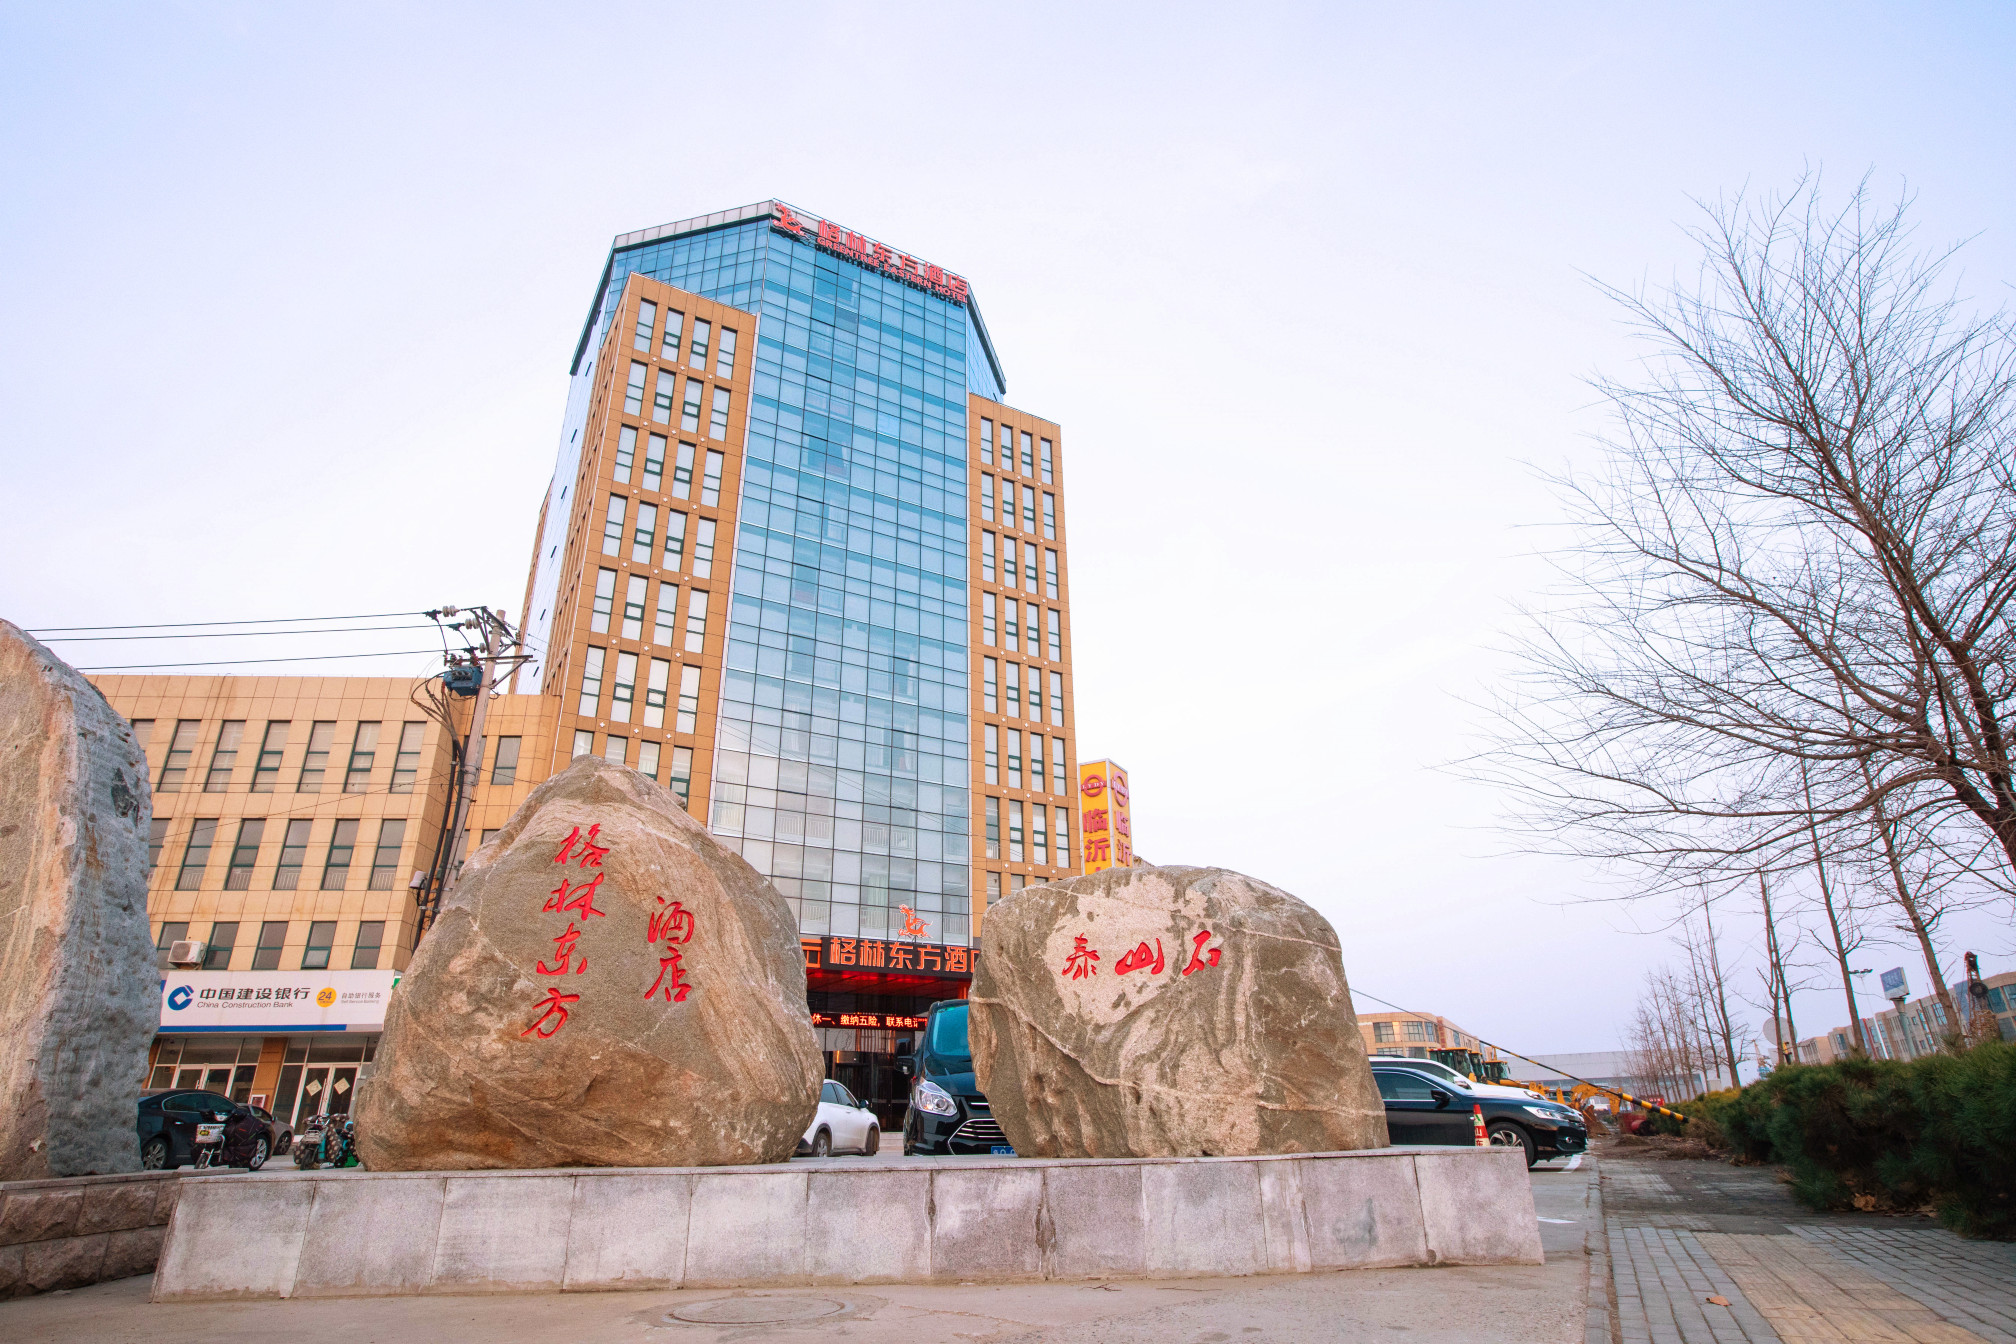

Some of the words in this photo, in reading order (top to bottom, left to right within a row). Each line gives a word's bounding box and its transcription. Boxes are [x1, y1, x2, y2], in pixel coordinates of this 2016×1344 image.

[816, 236, 880, 268] GREENTREE
[883, 264, 932, 289] EASTERN
[935, 283, 968, 304] HOTEL
[818, 219, 968, 296] 格林东方酒店
[1083, 808, 1111, 872] 临沂
[644, 896, 695, 1002] 酒店
[829, 936, 981, 973] 格林东方酒
[1062, 930, 1221, 980] 泰山石
[199, 987, 311, 1000] 中国建设银行
[318, 991, 333, 1001] 24
